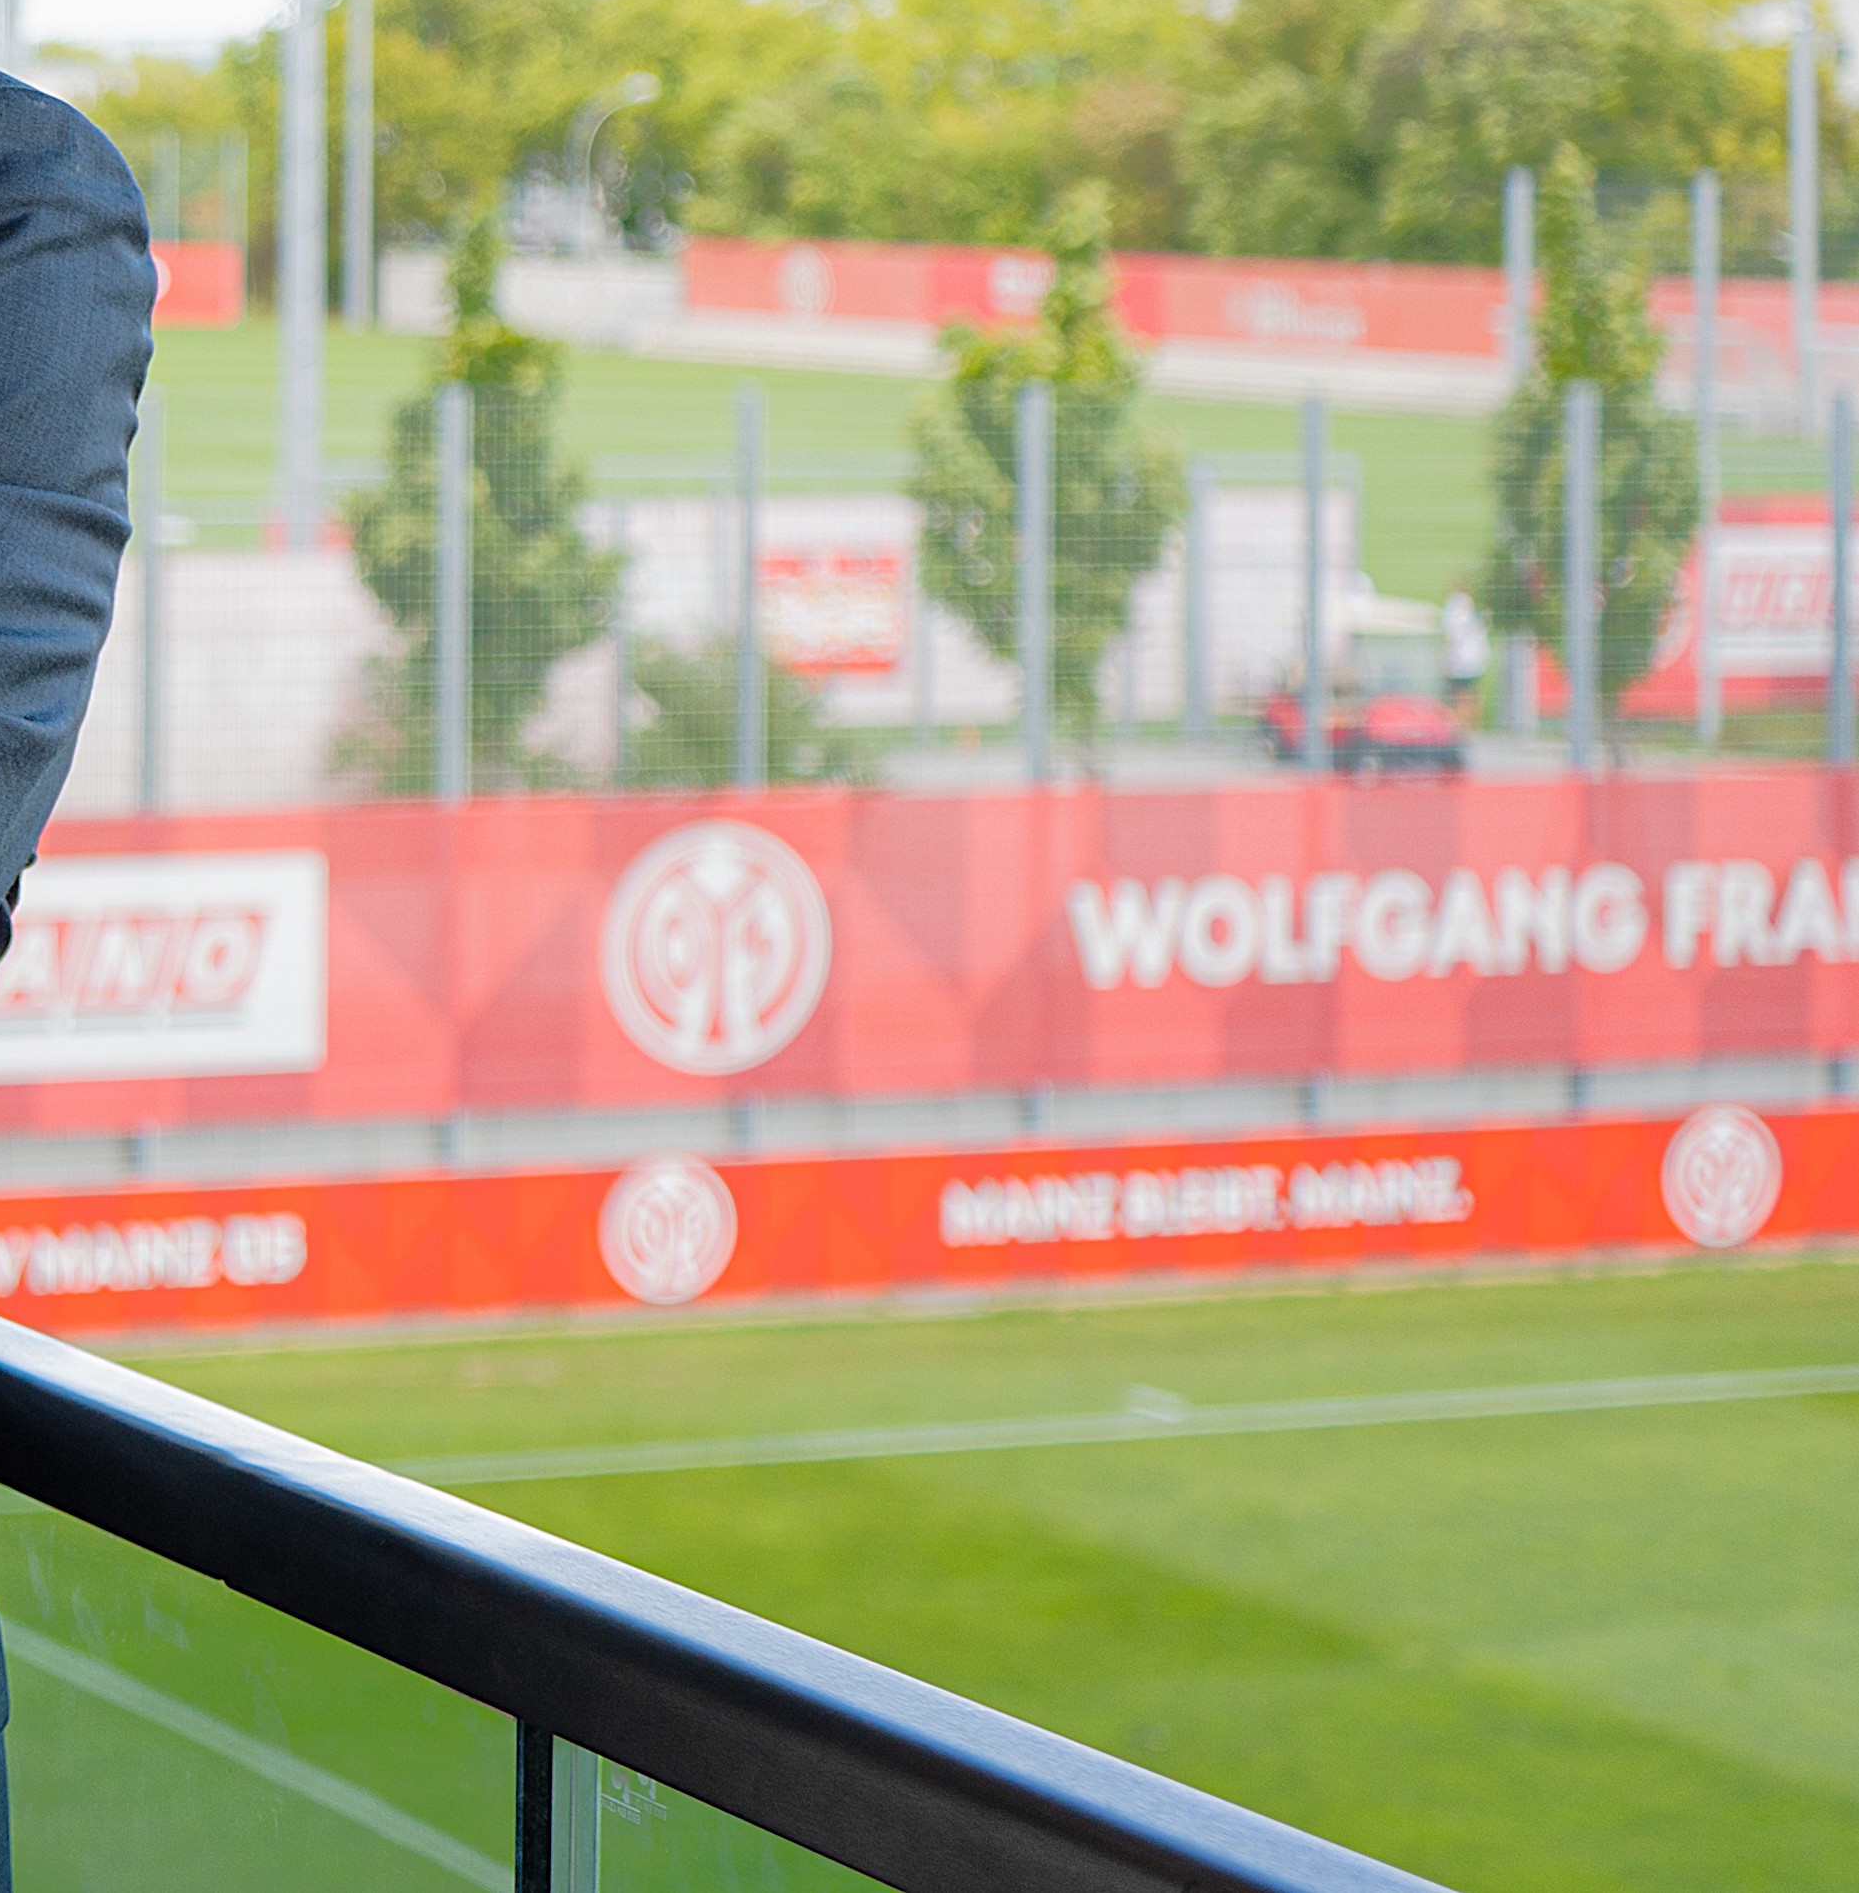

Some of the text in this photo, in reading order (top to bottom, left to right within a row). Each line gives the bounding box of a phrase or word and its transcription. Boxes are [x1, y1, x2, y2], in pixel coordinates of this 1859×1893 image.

[1066, 860, 1647, 991] WOLFGANG
[26, 1218, 220, 1296] MAINZ
[221, 1210, 308, 1287] 05
[940, 1173, 1119, 1248] MAINZ
